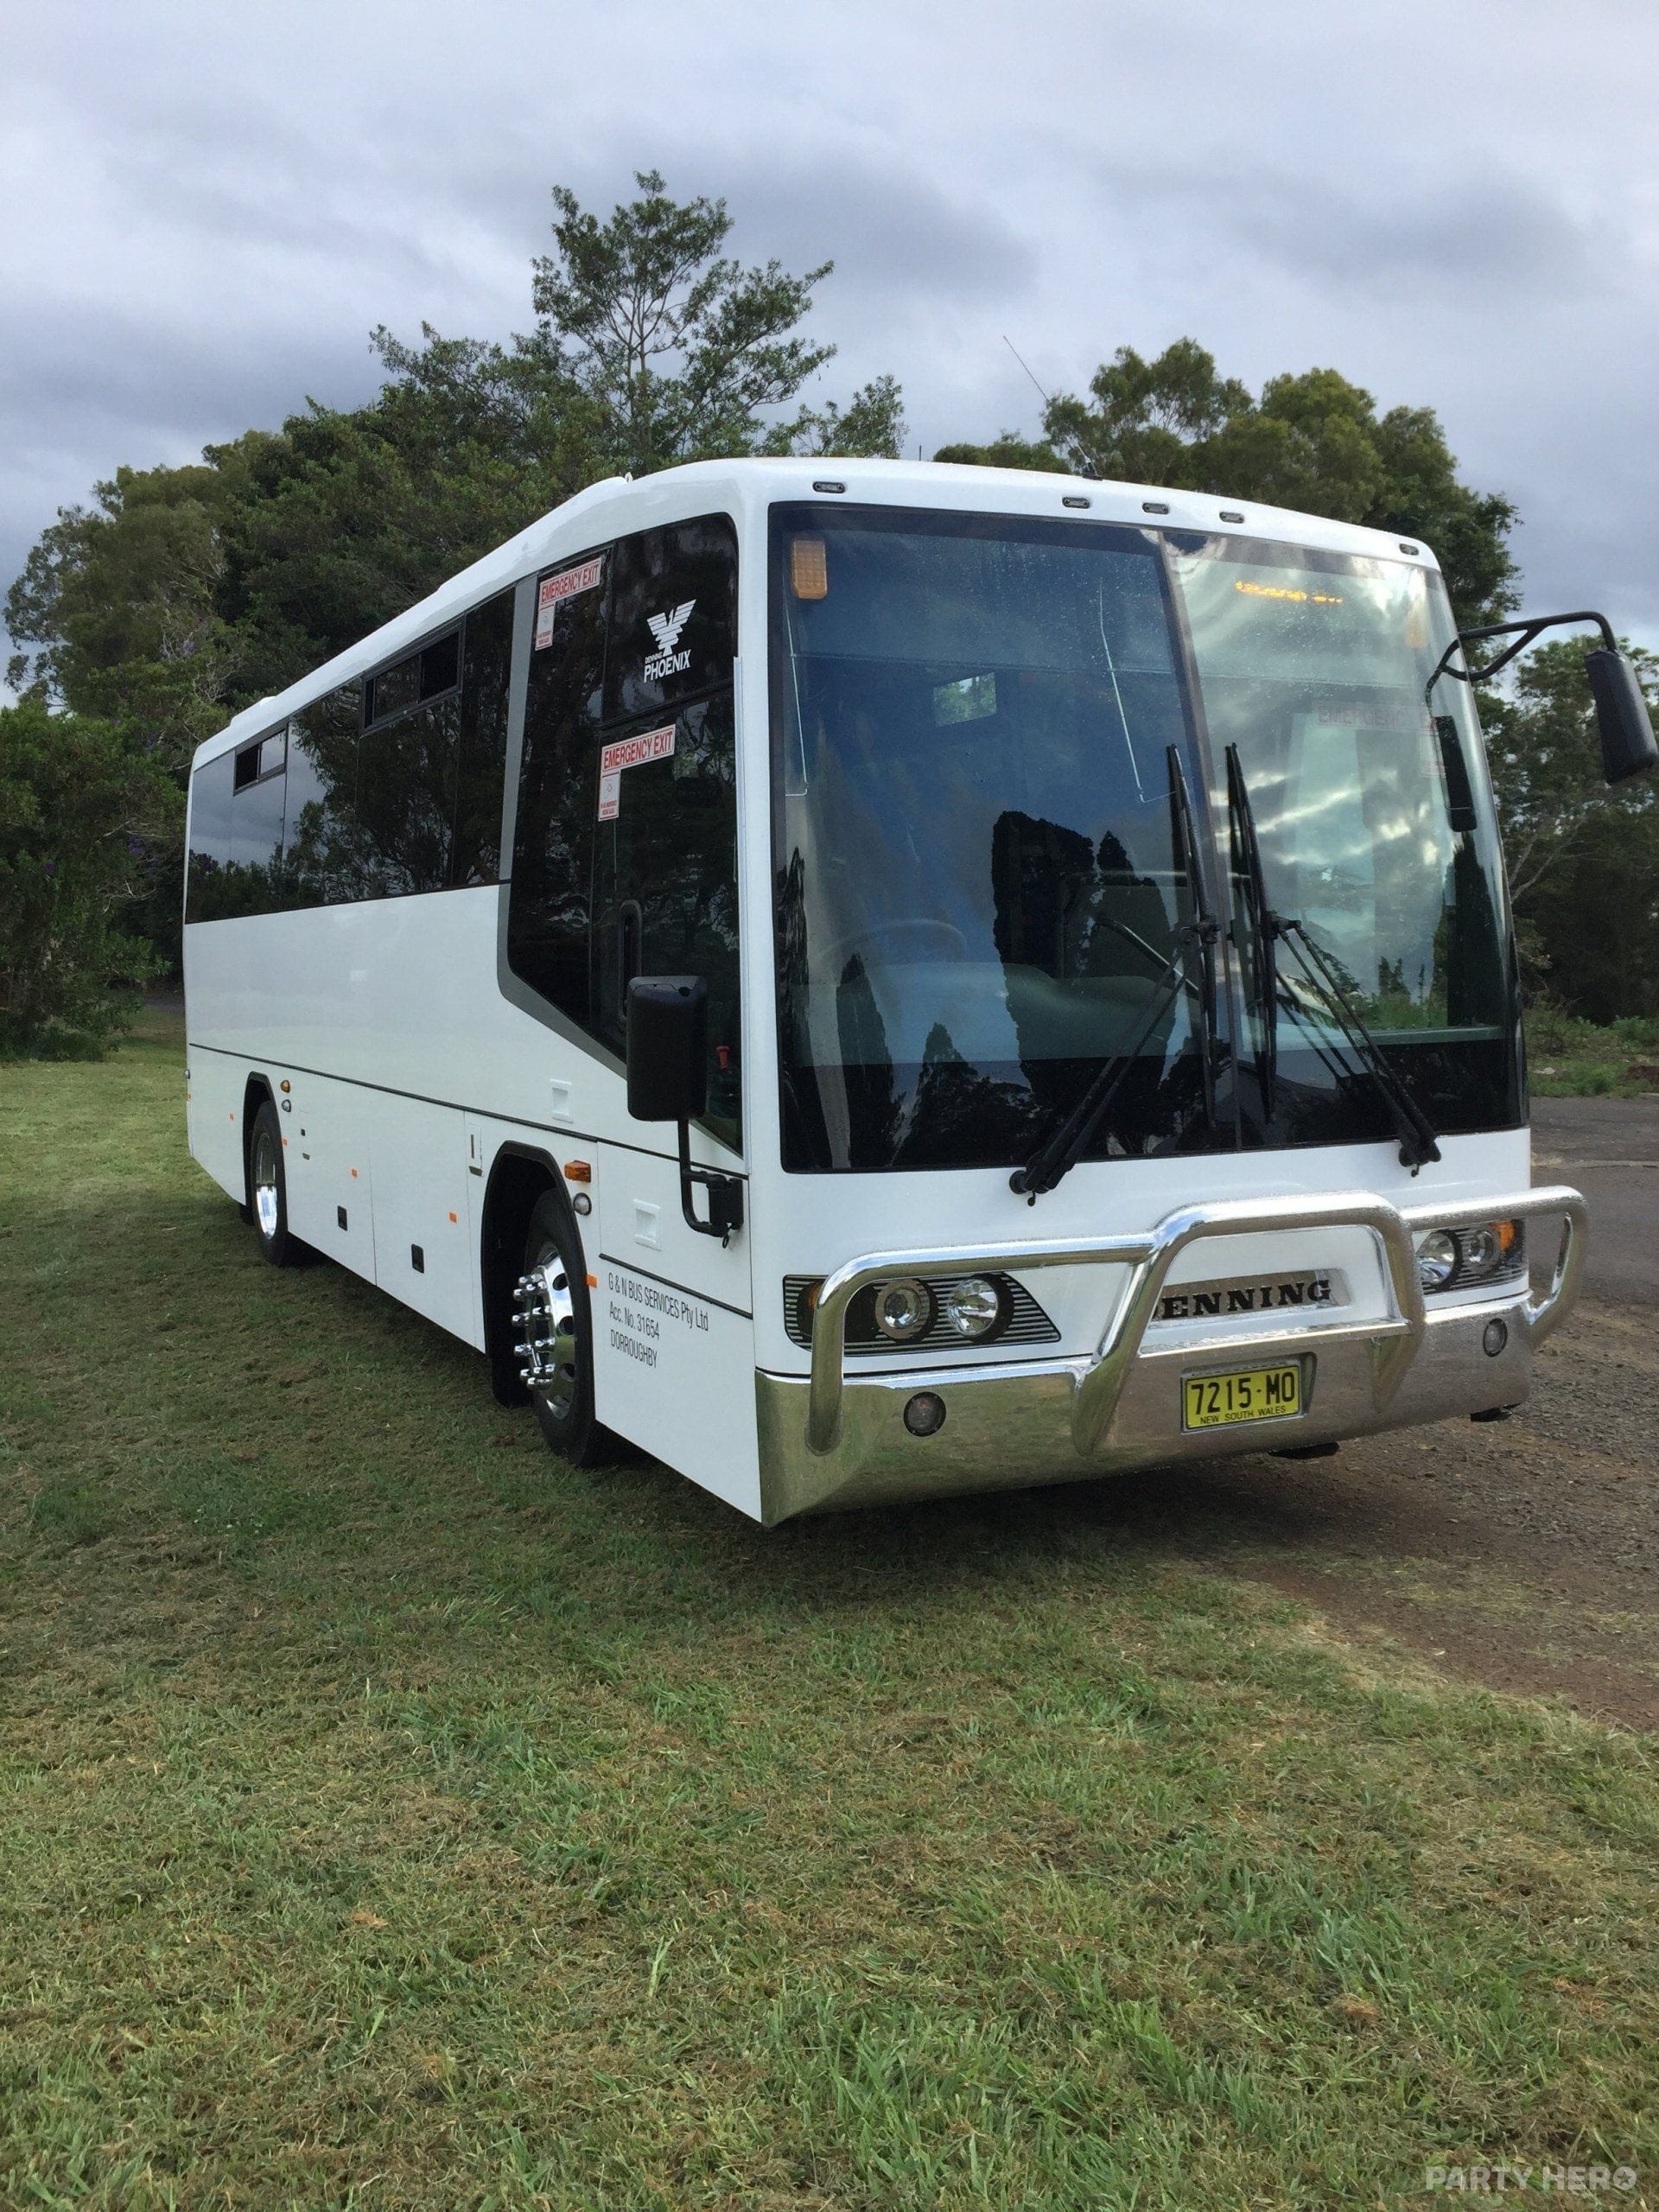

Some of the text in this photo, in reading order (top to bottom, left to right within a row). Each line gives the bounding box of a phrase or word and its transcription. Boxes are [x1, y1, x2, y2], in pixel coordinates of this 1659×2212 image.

[541, 564, 599, 603] EMERGENCY EXIT
[644, 649, 692, 683] PHOENIX
[603, 731, 673, 770] EMERGENCY EXIT
[608, 1272, 709, 1332] G & N BUS SERVICES Pty Ltd
[1153, 1280, 1332, 1321] ENNING
[609, 1301, 660, 1340] Acc. No. 31654
[610, 1329, 658, 1369] DORROUGHBY
[1200, 1405, 1287, 1425] NEW SOUTH WALES
